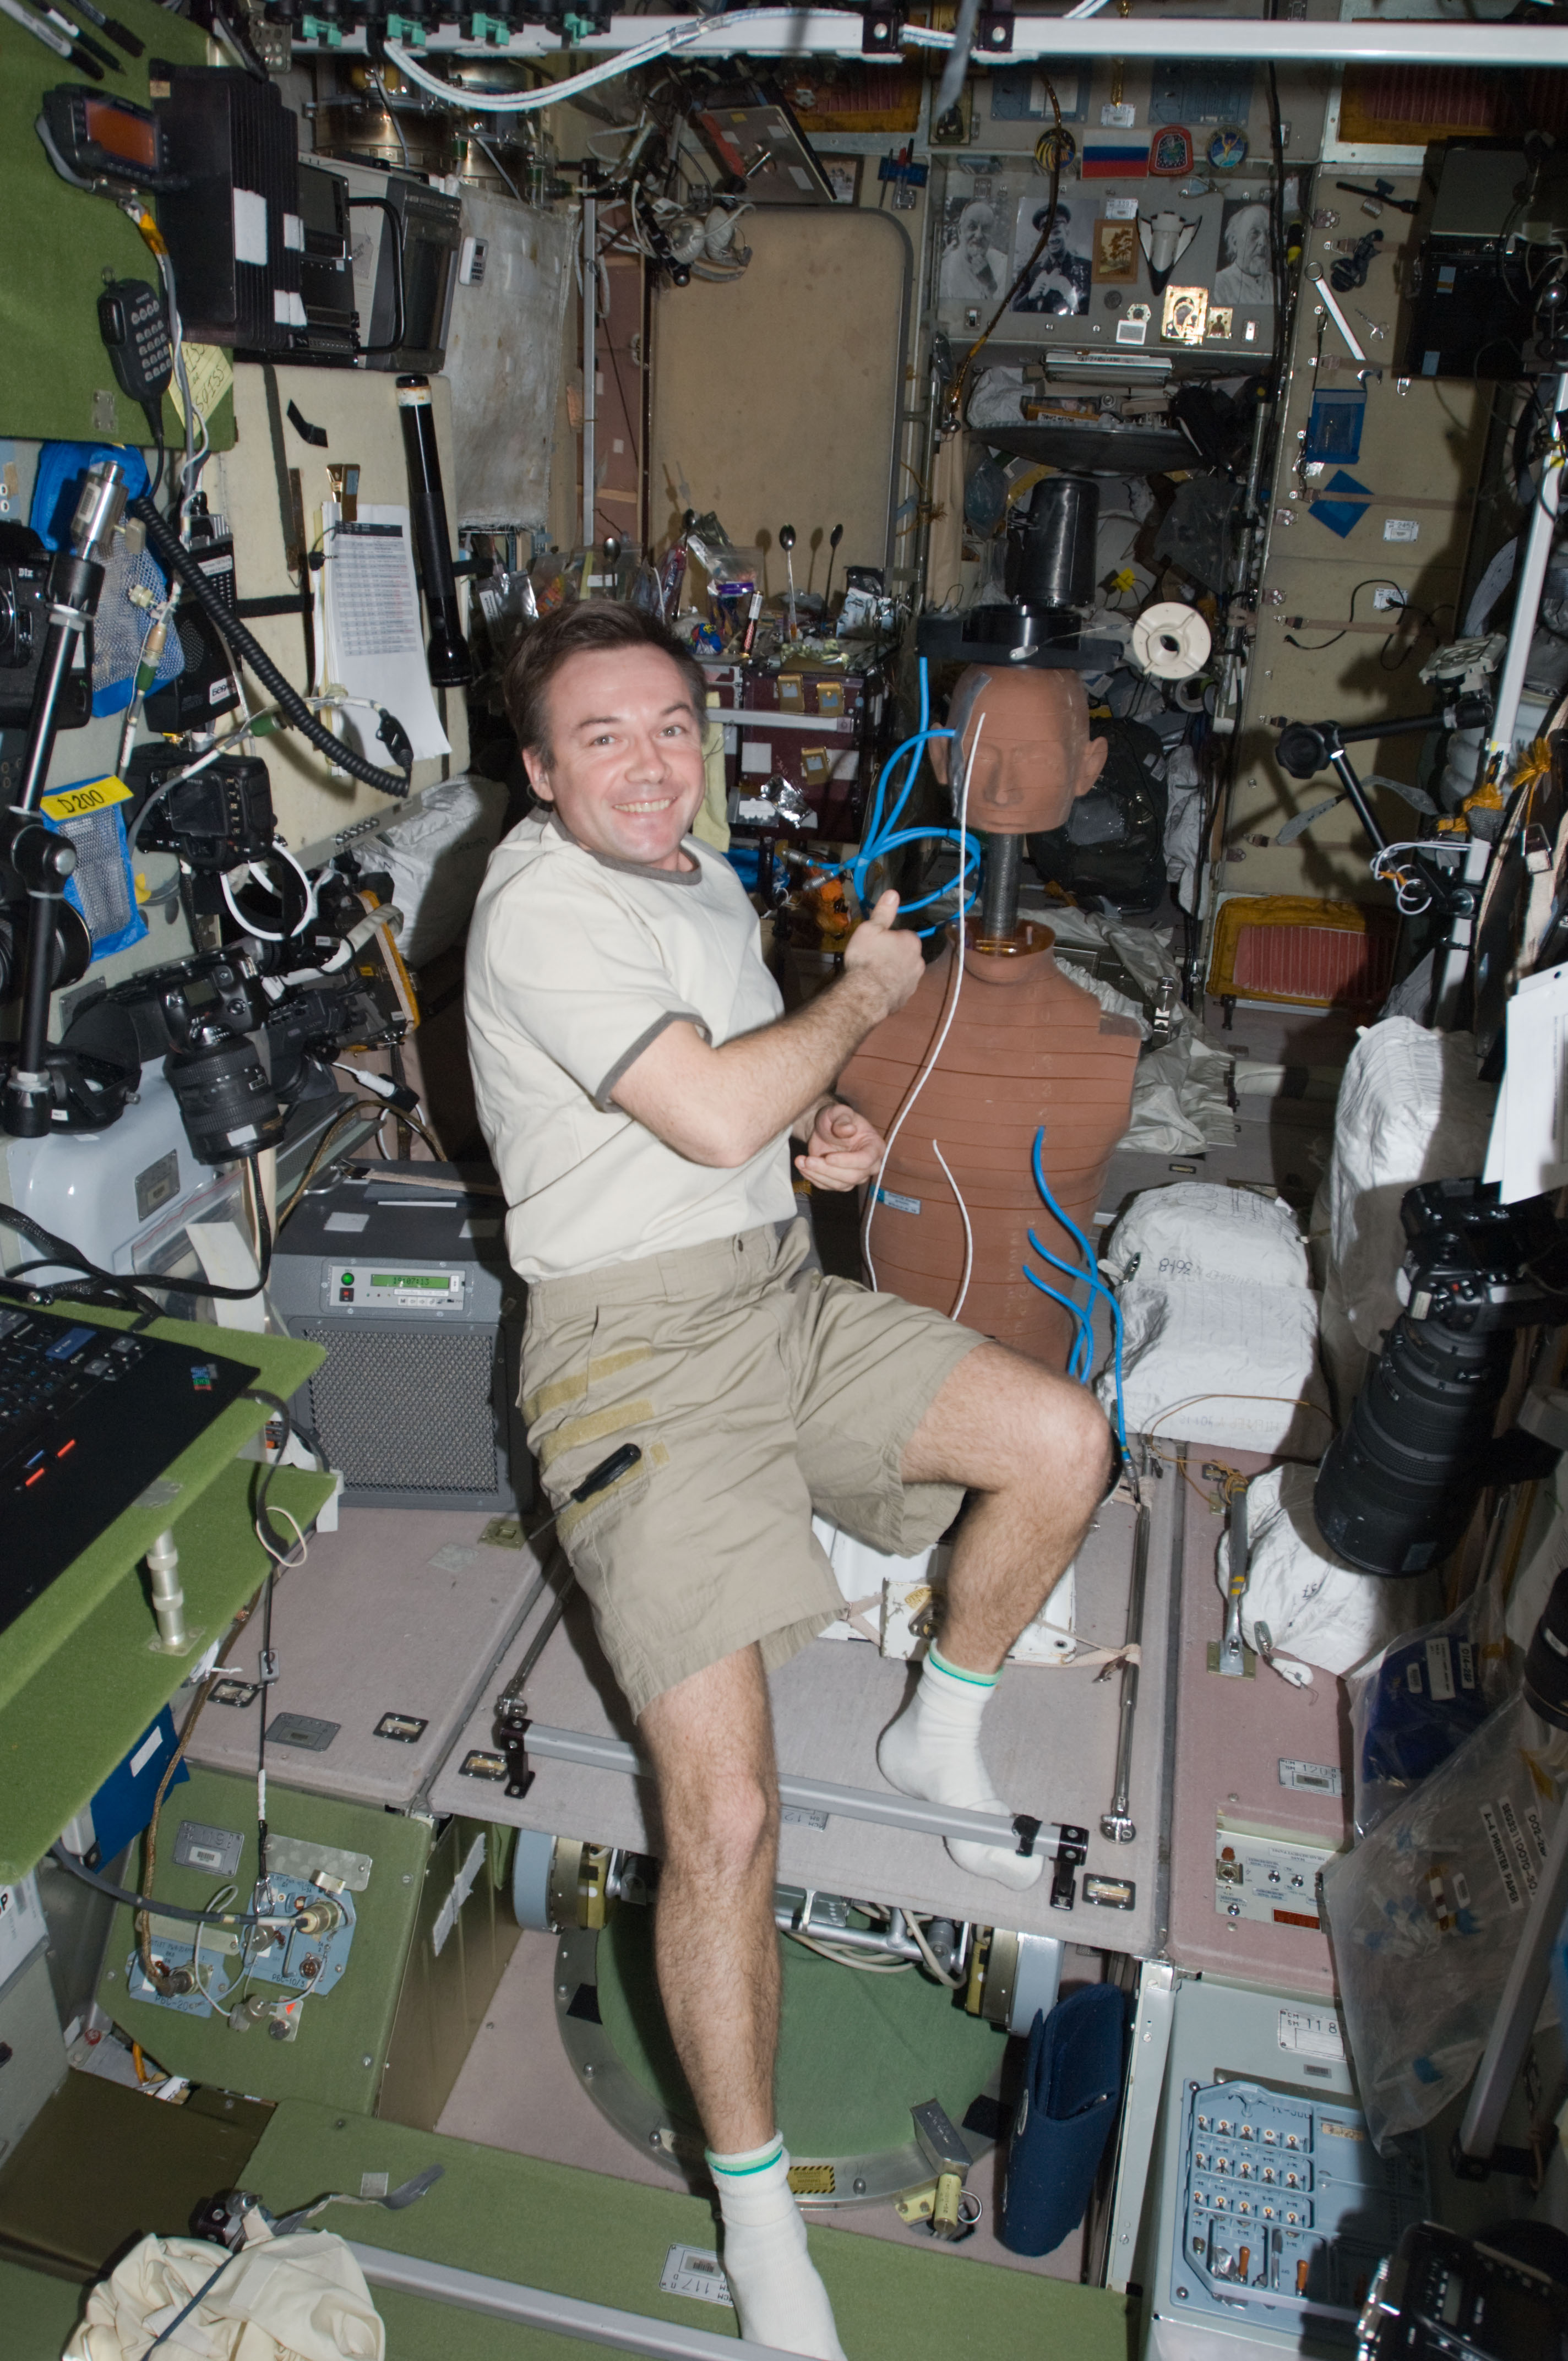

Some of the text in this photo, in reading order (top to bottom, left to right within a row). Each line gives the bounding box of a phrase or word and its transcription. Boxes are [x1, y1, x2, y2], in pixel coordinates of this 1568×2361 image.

[57, 790, 105, 813] D200
[1303, 1764, 1327, 1776] 120
[1491, 1832, 1509, 1872] PRINTER
[1504, 1873, 1520, 1904] PAPER
[1307, 2018, 1337, 2034] 118
[682, 2278, 709, 2294] 117
